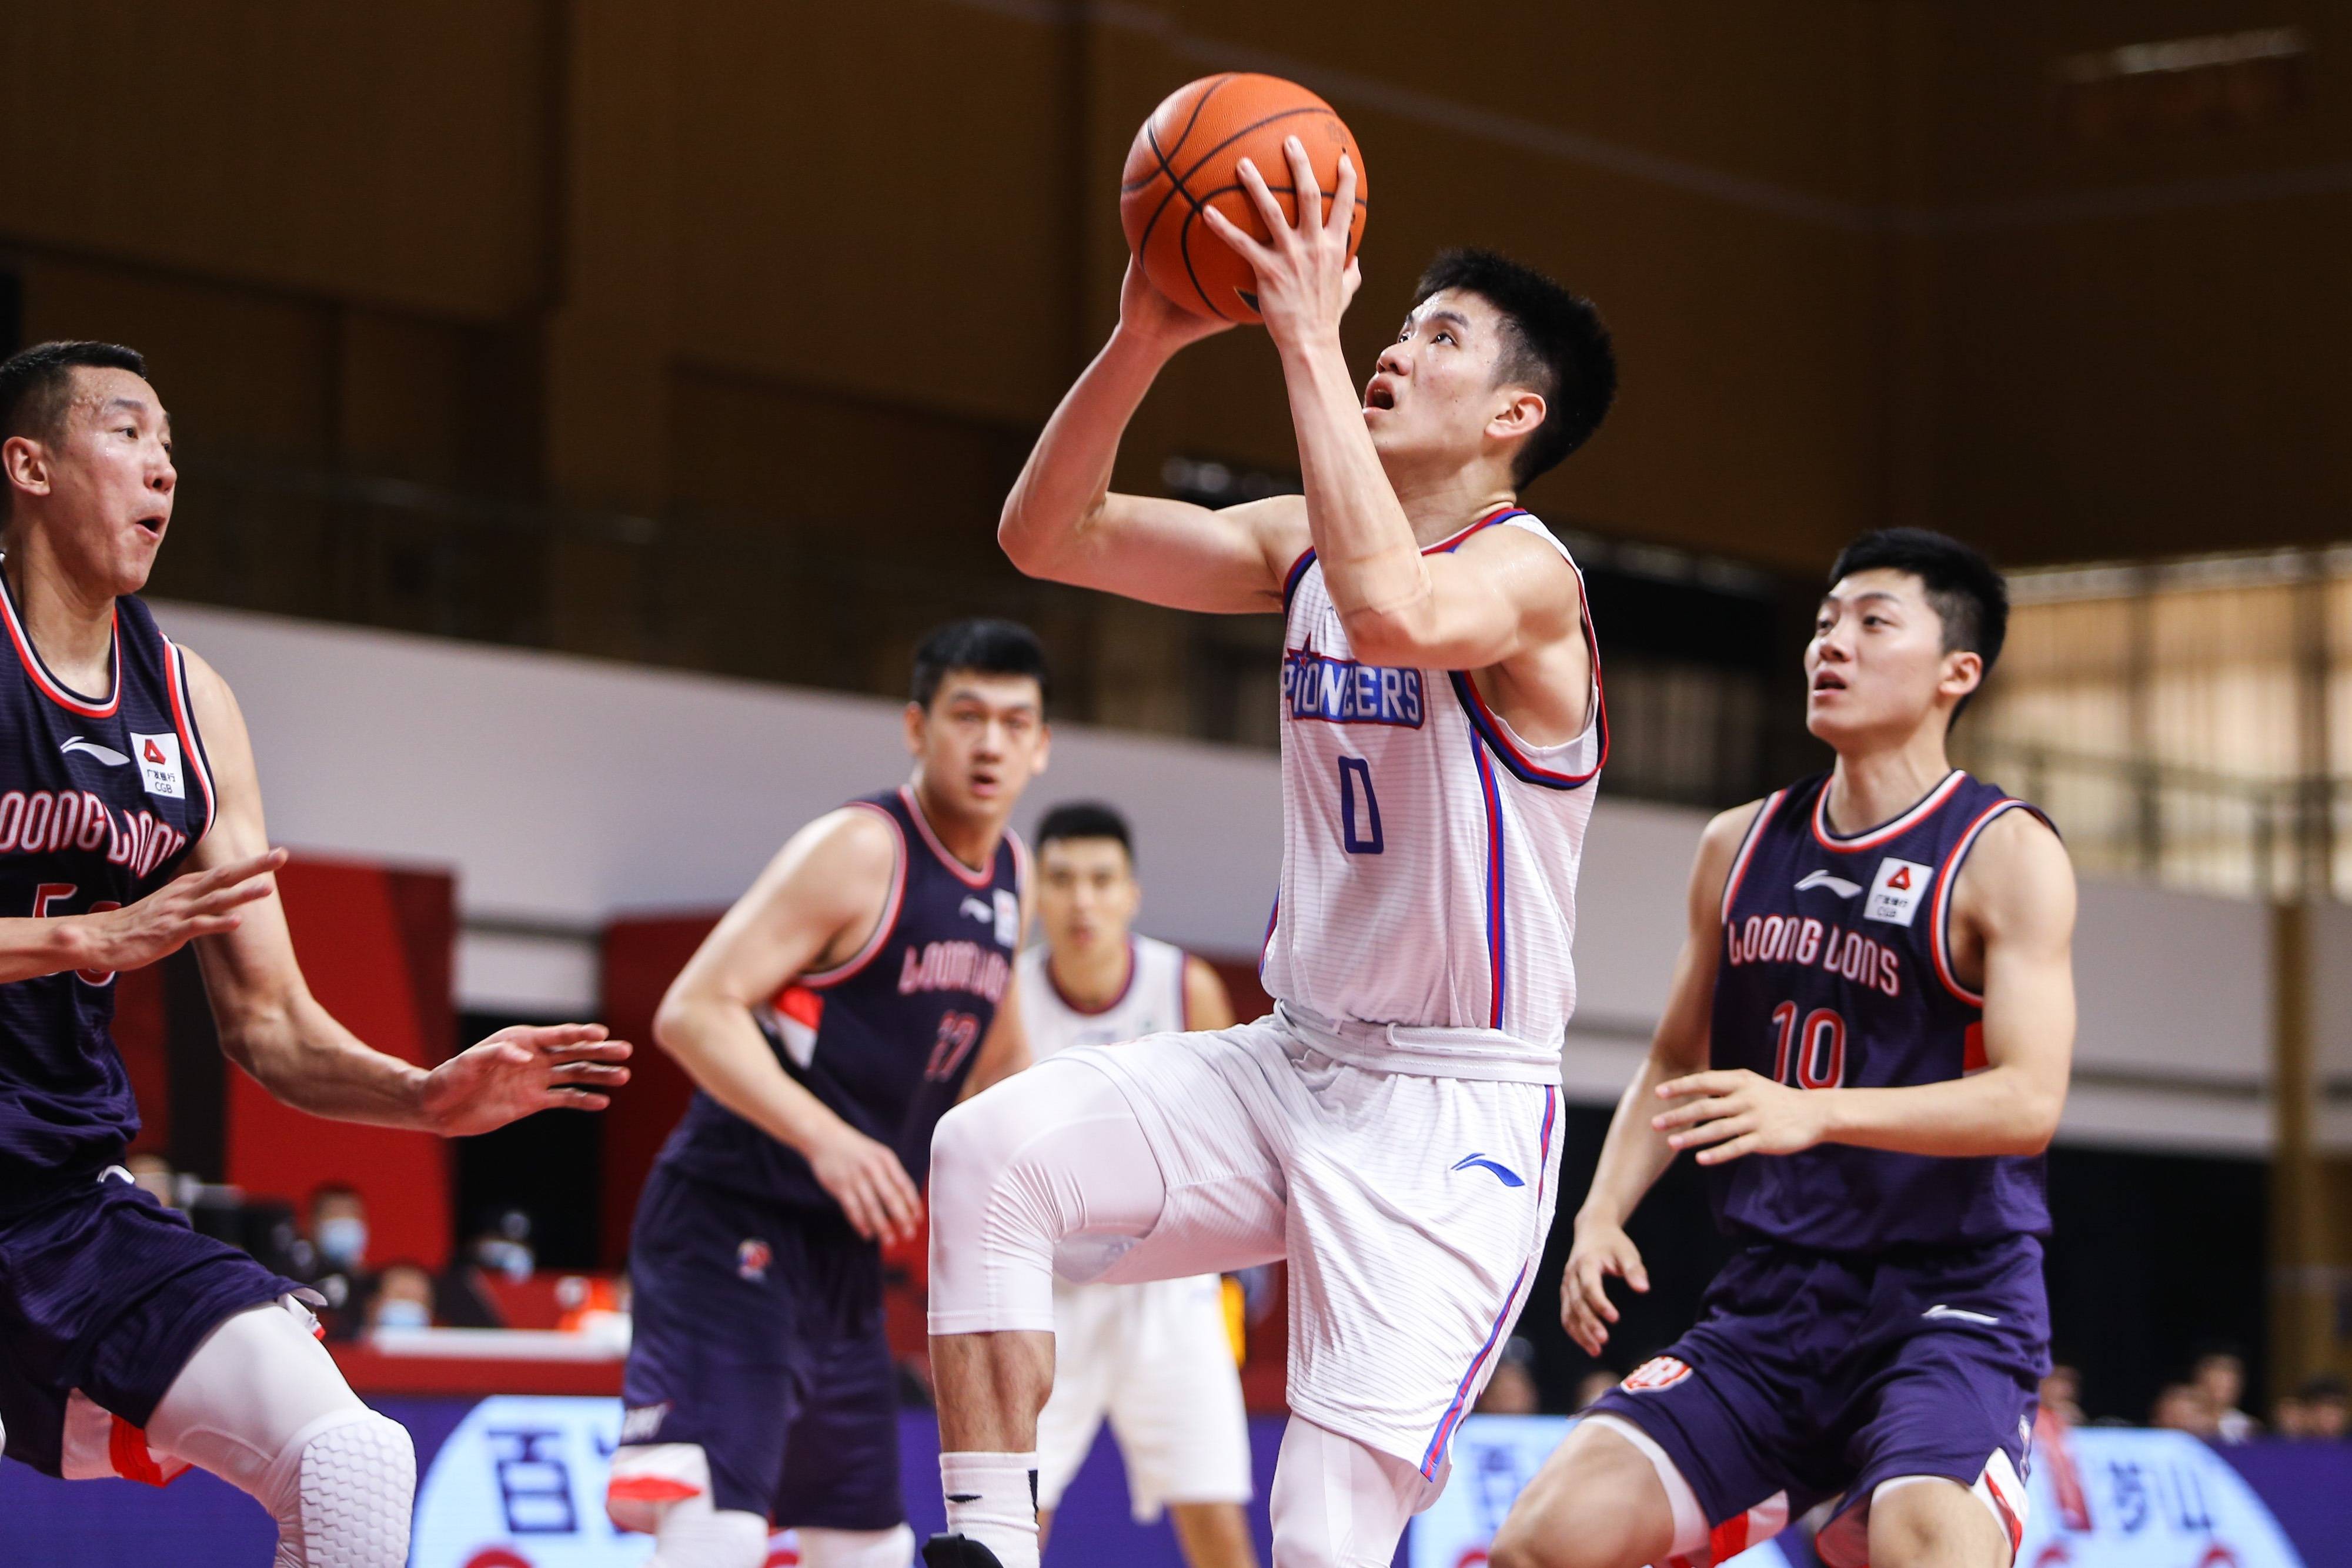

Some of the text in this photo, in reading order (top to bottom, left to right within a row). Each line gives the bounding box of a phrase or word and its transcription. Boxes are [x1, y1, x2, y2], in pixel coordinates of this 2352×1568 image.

[1284, 662, 1420, 723] PIONEERS
[155, 781, 173, 794] CGB
[1338, 755, 1384, 854] 0
[1728, 913, 1824, 967] LOONG
[1772, 1000, 1846, 1089] 10
